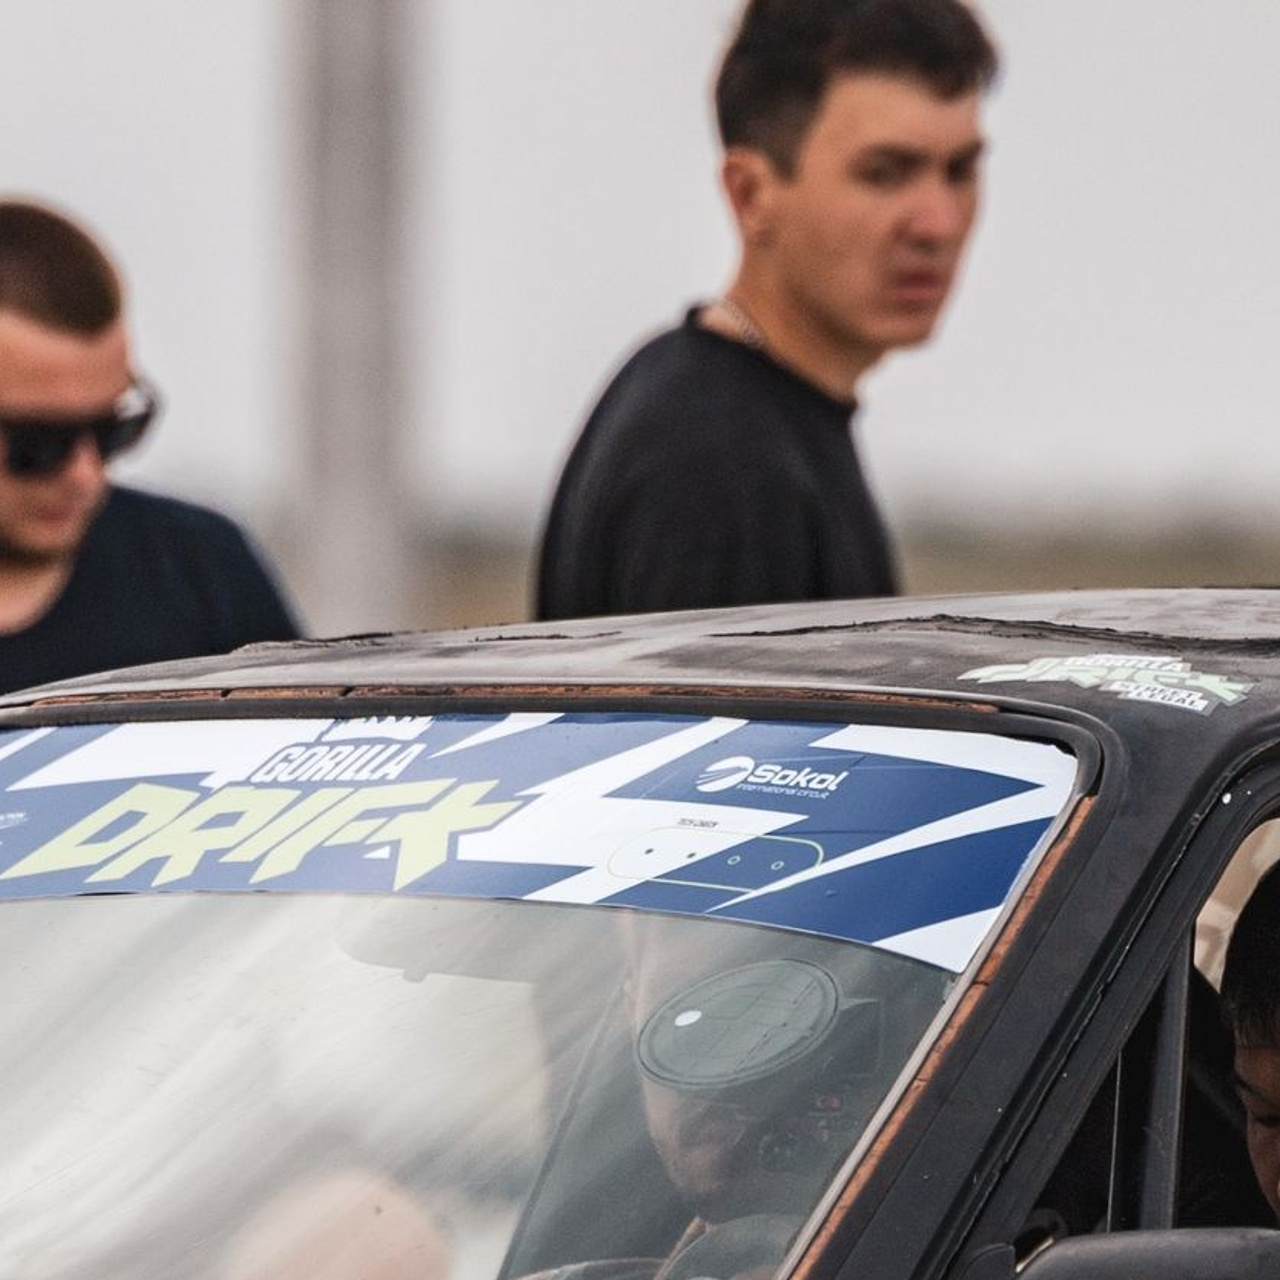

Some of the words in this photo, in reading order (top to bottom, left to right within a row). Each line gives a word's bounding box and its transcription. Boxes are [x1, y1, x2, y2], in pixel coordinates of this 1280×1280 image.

[253, 743, 426, 783] GORILLA
[747, 764, 848, 791] Sokol
[0, 778, 534, 892] DRIFT
